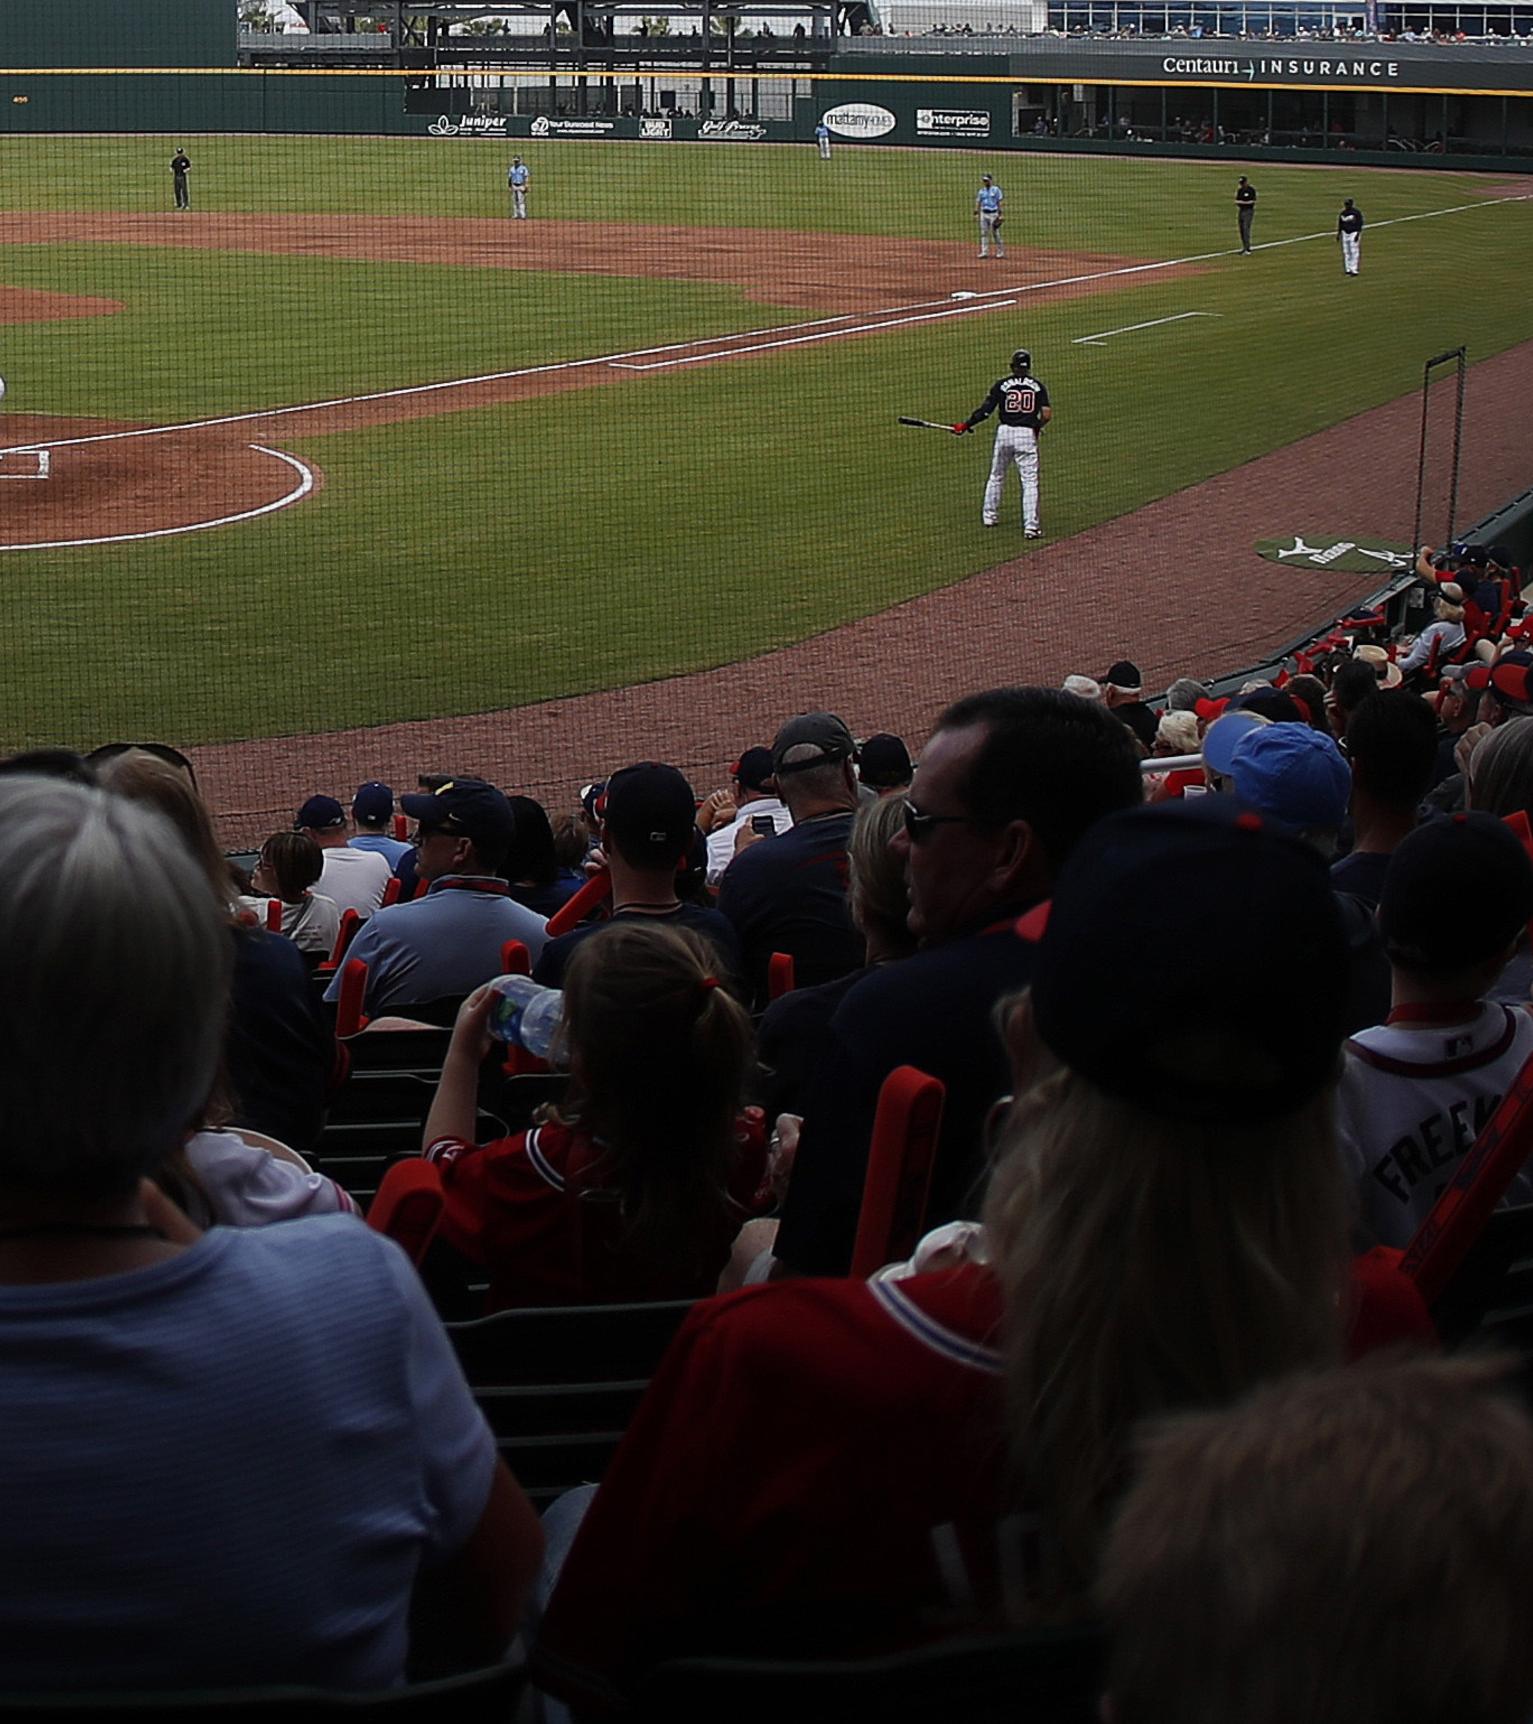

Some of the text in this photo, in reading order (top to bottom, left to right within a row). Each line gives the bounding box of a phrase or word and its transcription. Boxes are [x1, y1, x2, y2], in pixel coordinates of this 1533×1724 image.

[1163, 57, 1399, 77] Centauri INSURANCE
[459, 115, 507, 128] Juniper
[641, 128, 669, 137] LIGHT
[1005, 389, 1036, 413] 20
